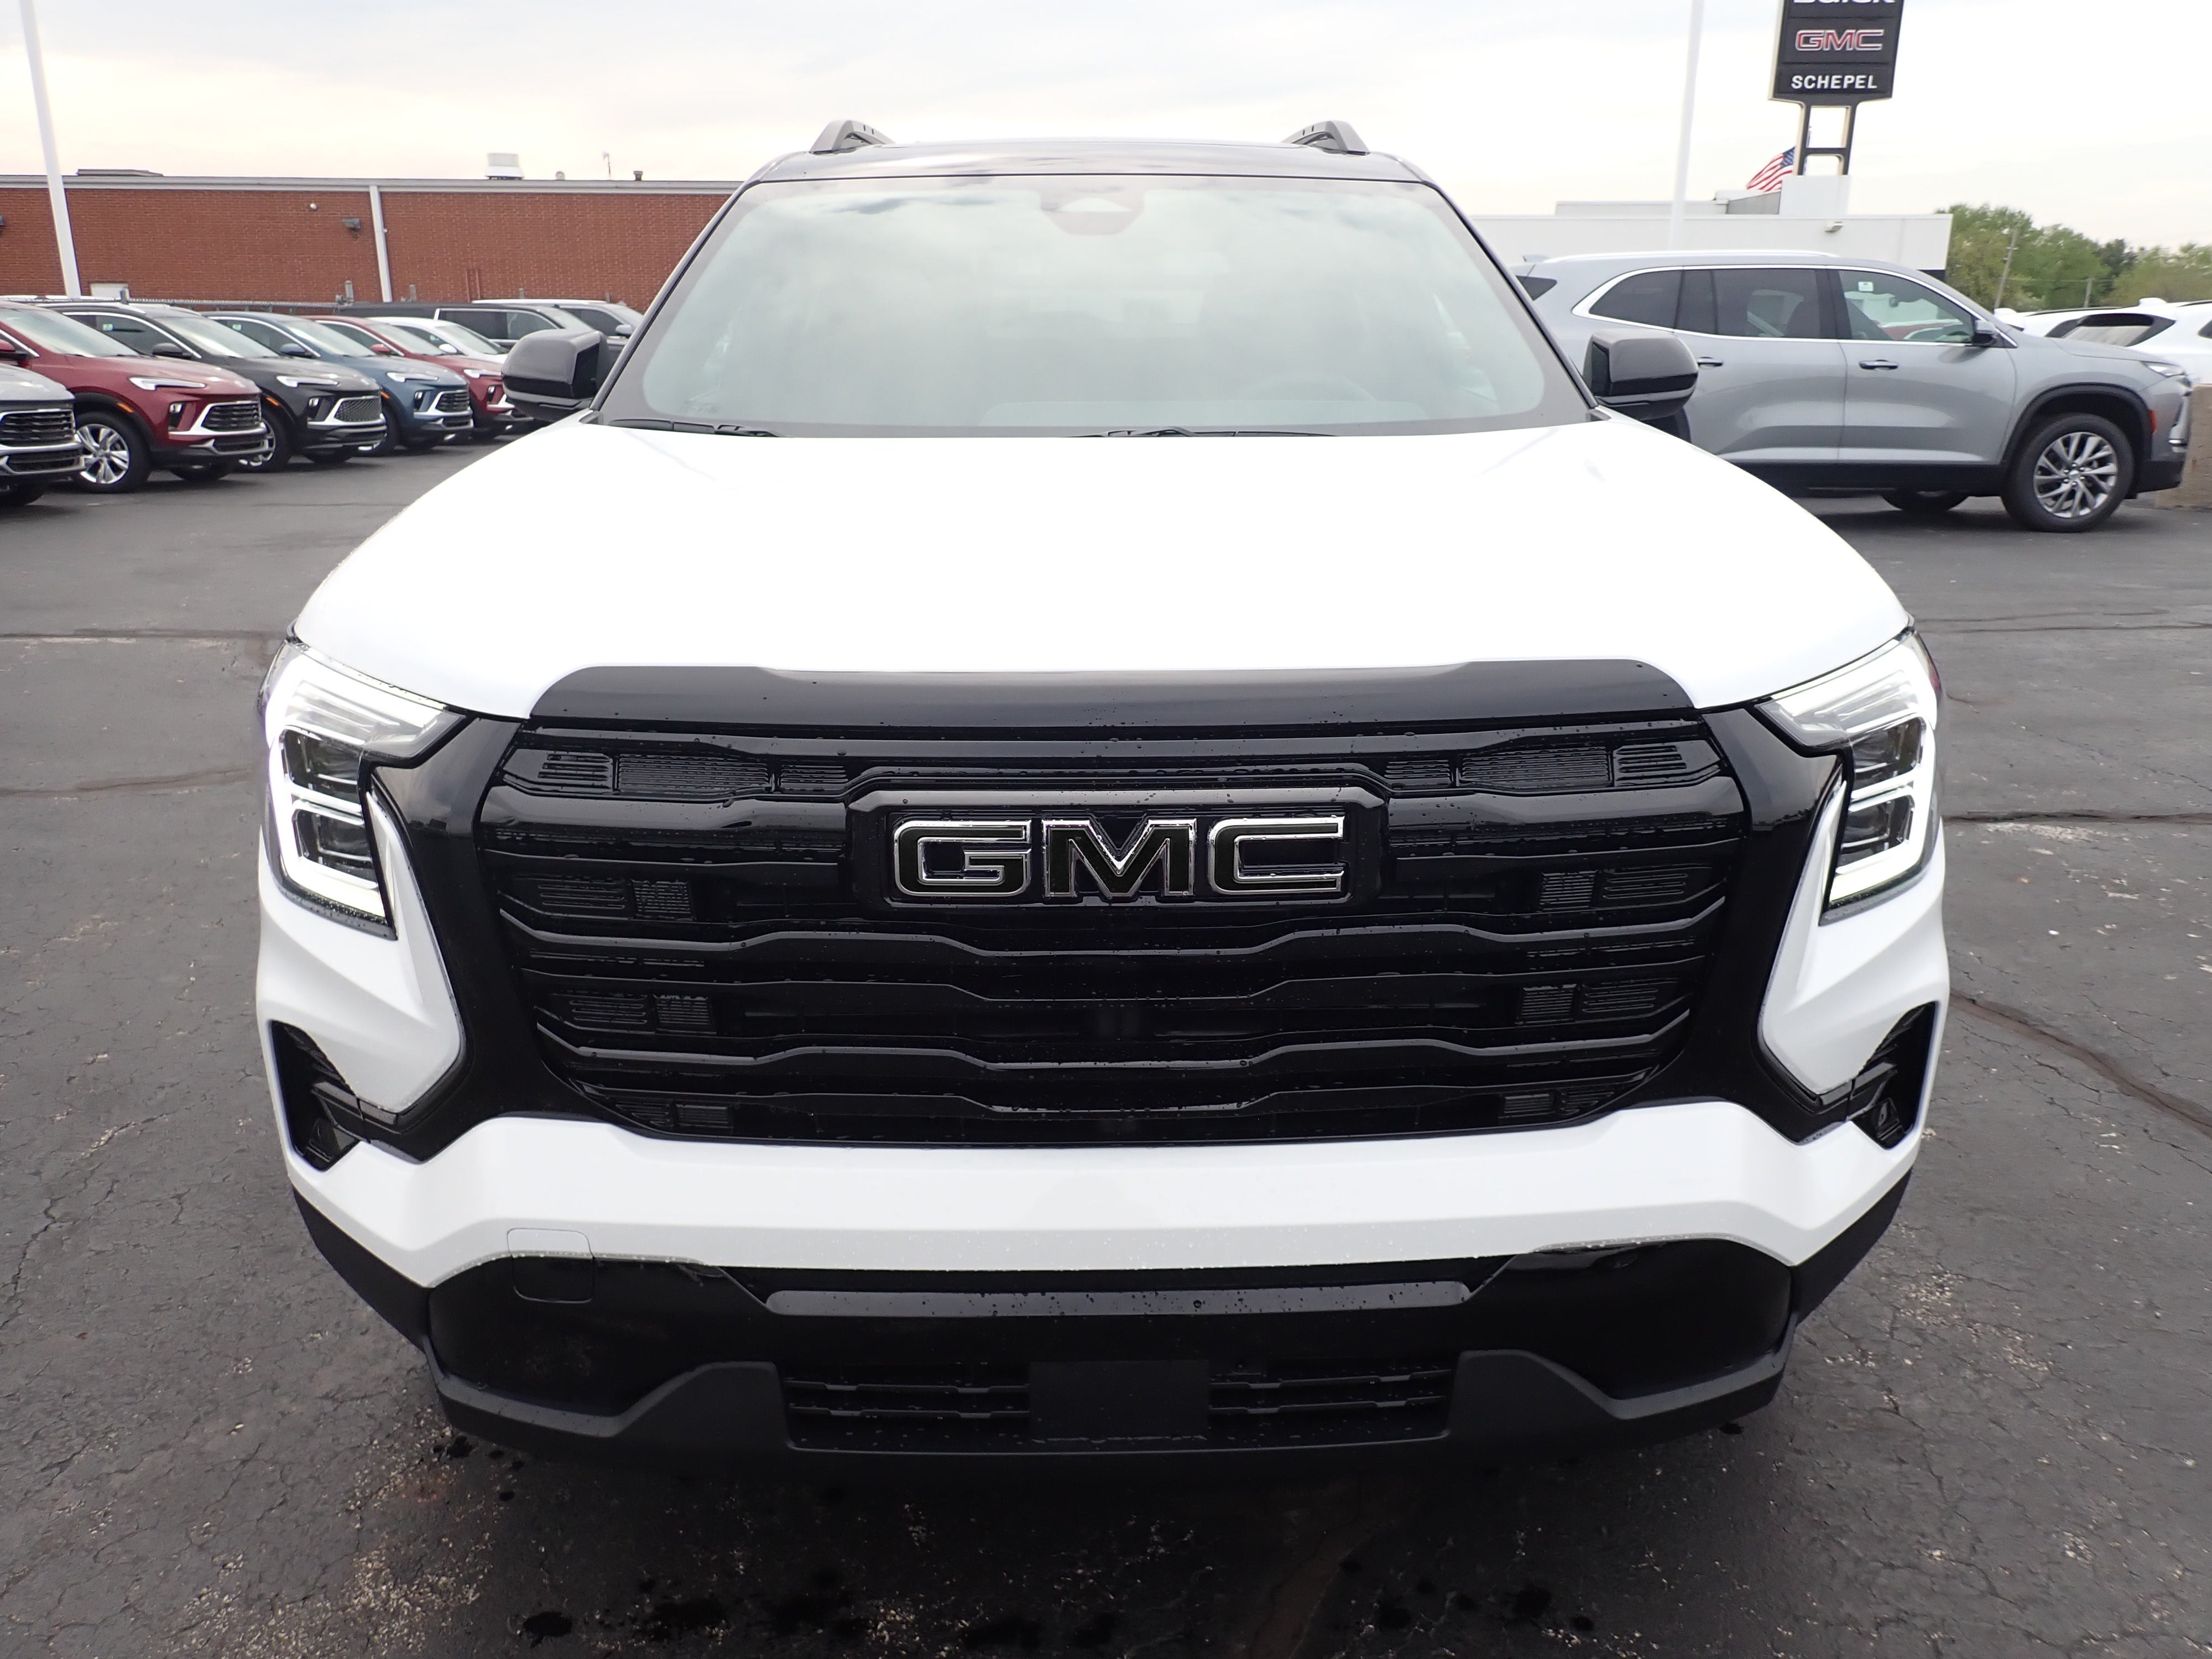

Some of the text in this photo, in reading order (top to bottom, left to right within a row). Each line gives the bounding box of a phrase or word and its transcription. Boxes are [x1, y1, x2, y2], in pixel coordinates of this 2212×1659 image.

[1796, 29, 1884, 51] GMC
[1791, 75, 1877, 89] SCHEPEL
[893, 817, 1345, 898] GMC
